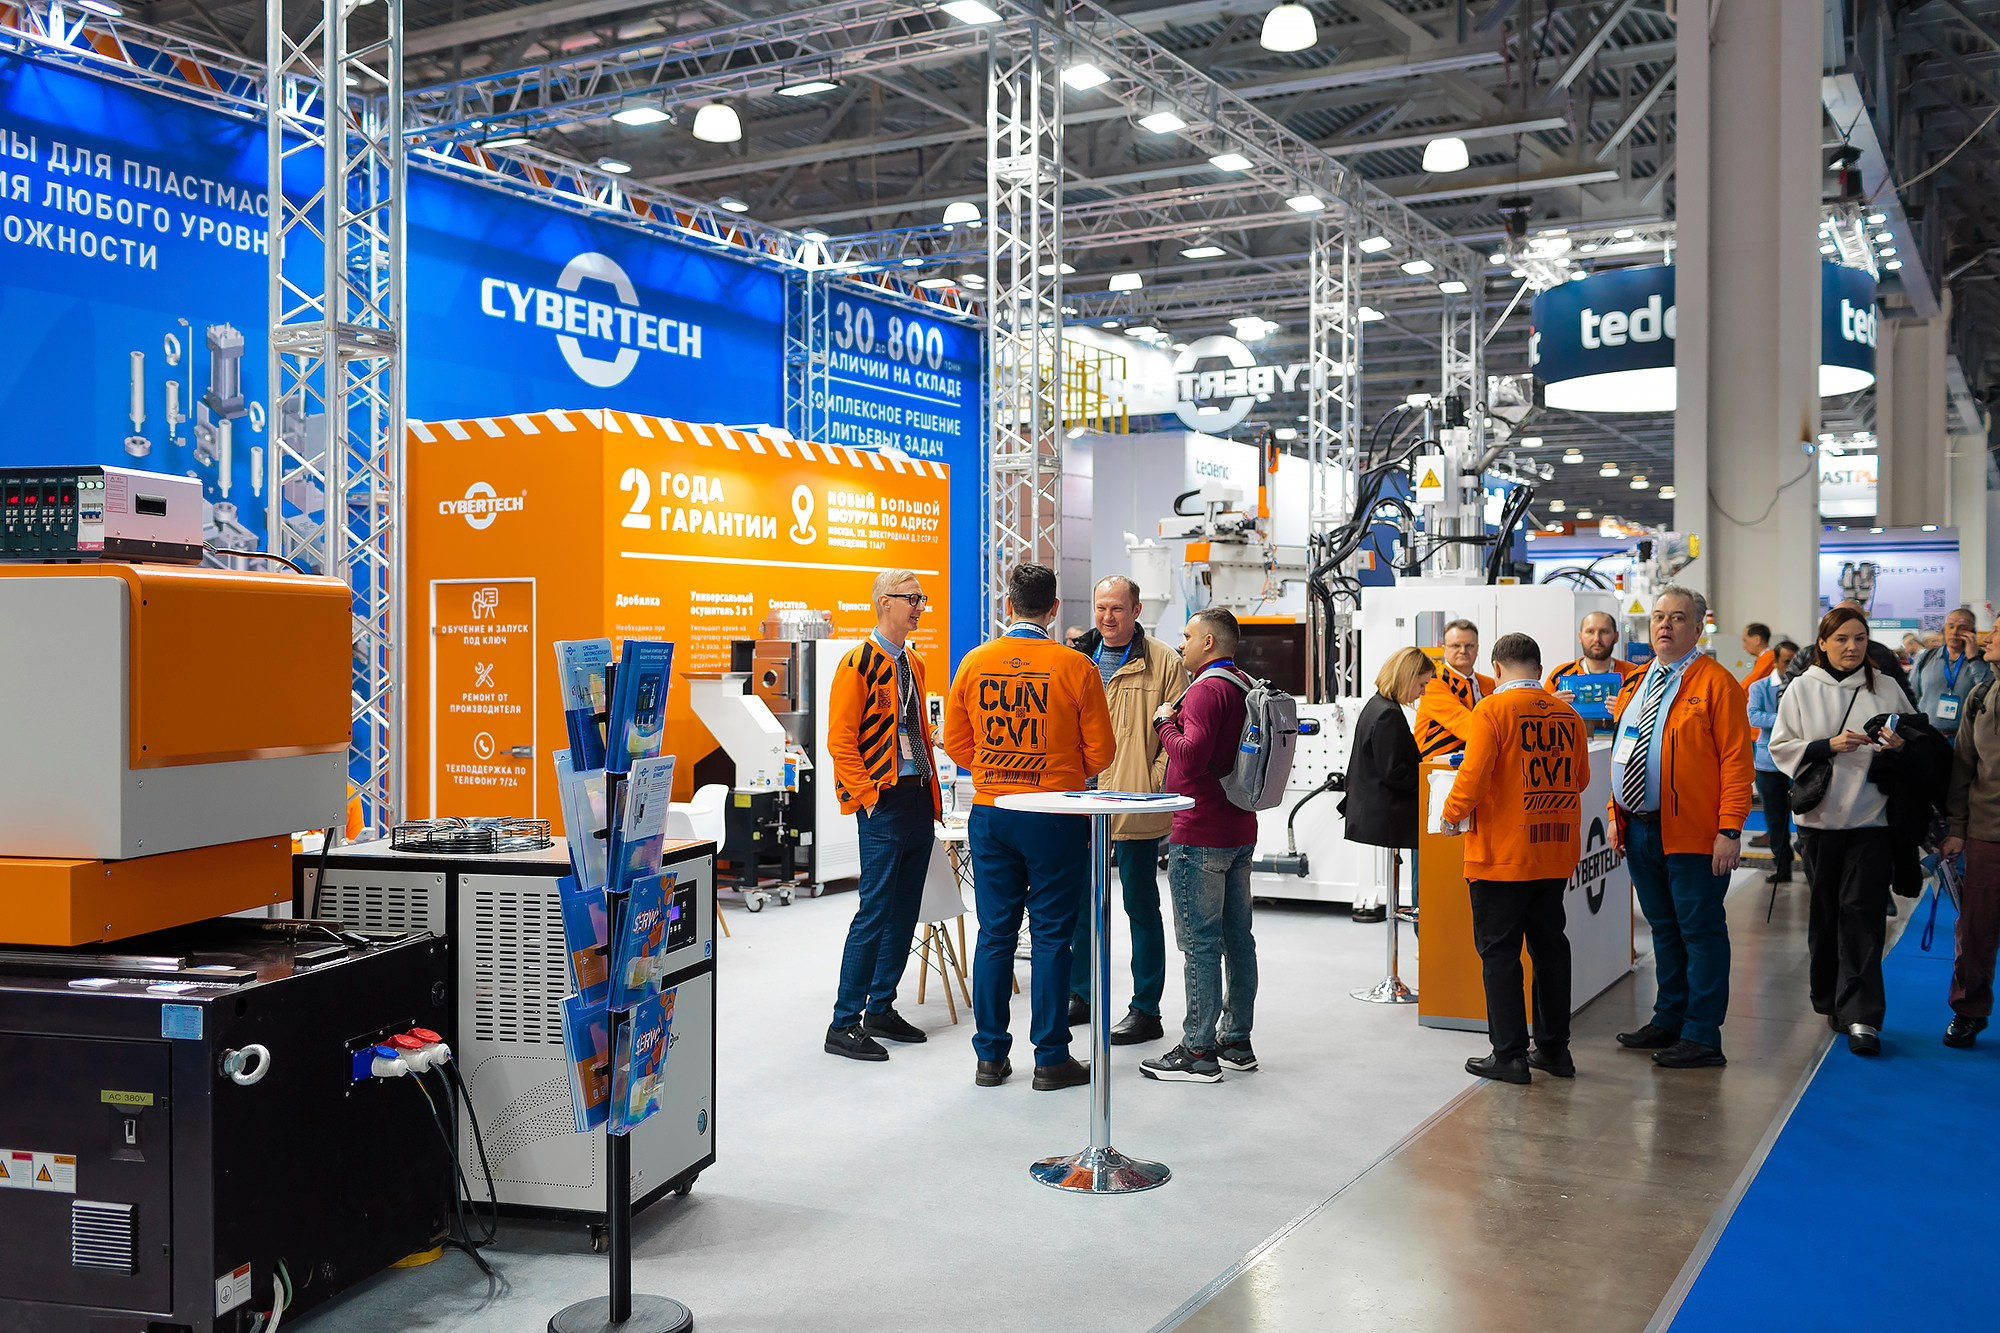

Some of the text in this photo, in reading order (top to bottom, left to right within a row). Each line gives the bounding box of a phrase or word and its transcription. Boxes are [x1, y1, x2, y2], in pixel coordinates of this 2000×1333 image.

[47, 141, 111, 180] ДЛЯ
[123, 159, 286, 221] ПЛАСТМАС
[42, 181, 170, 233] ЛЮБОГО
[481, 277, 702, 359] CYBERTECH
[835, 301, 875, 354] 30
[888, 316, 944, 371] 800
[829, 350, 962, 398] АЛИЧИИ НА СКЛАДЕ
[905, 409, 962, 436] РЕШЕНИЕ
[904, 435, 944, 458] ЗАДАЧ
[439, 497, 524, 515] CYBERTECH
[619, 467, 725, 530] 2 ГОДА
[827, 490, 940, 516] НОВЫЙ БОЛЬШОЙ
[660, 506, 777, 540] ГАРАНТИИ
[827, 507, 939, 532] ШОУРУМ ПО АДРЕСУ
[615, 593, 661, 608] Дробилка
[690, 590, 754, 605] Универсальный
[837, 600, 872, 612] Термостат
[690, 604, 735, 618] осушитель
[735, 605, 741, 616] 3
[749, 605, 754, 616] 1
[442, 624, 485, 634] ОБУЧЕНИЕ
[496, 624, 529, 633] ЗАПУСК
[464, 636, 507, 646] ПОД КЛЮЧ
[462, 693, 509, 702] РЕМОНТ ОТ
[450, 704, 521, 714] ПРОИЗВОДИТЕЛЯ
[446, 764, 526, 775] ТЕХПОДДЕРЖКА ПО
[454, 775, 498, 786] ТЕЛЕФОНУ
[108, 1093, 122, 1101] AC
